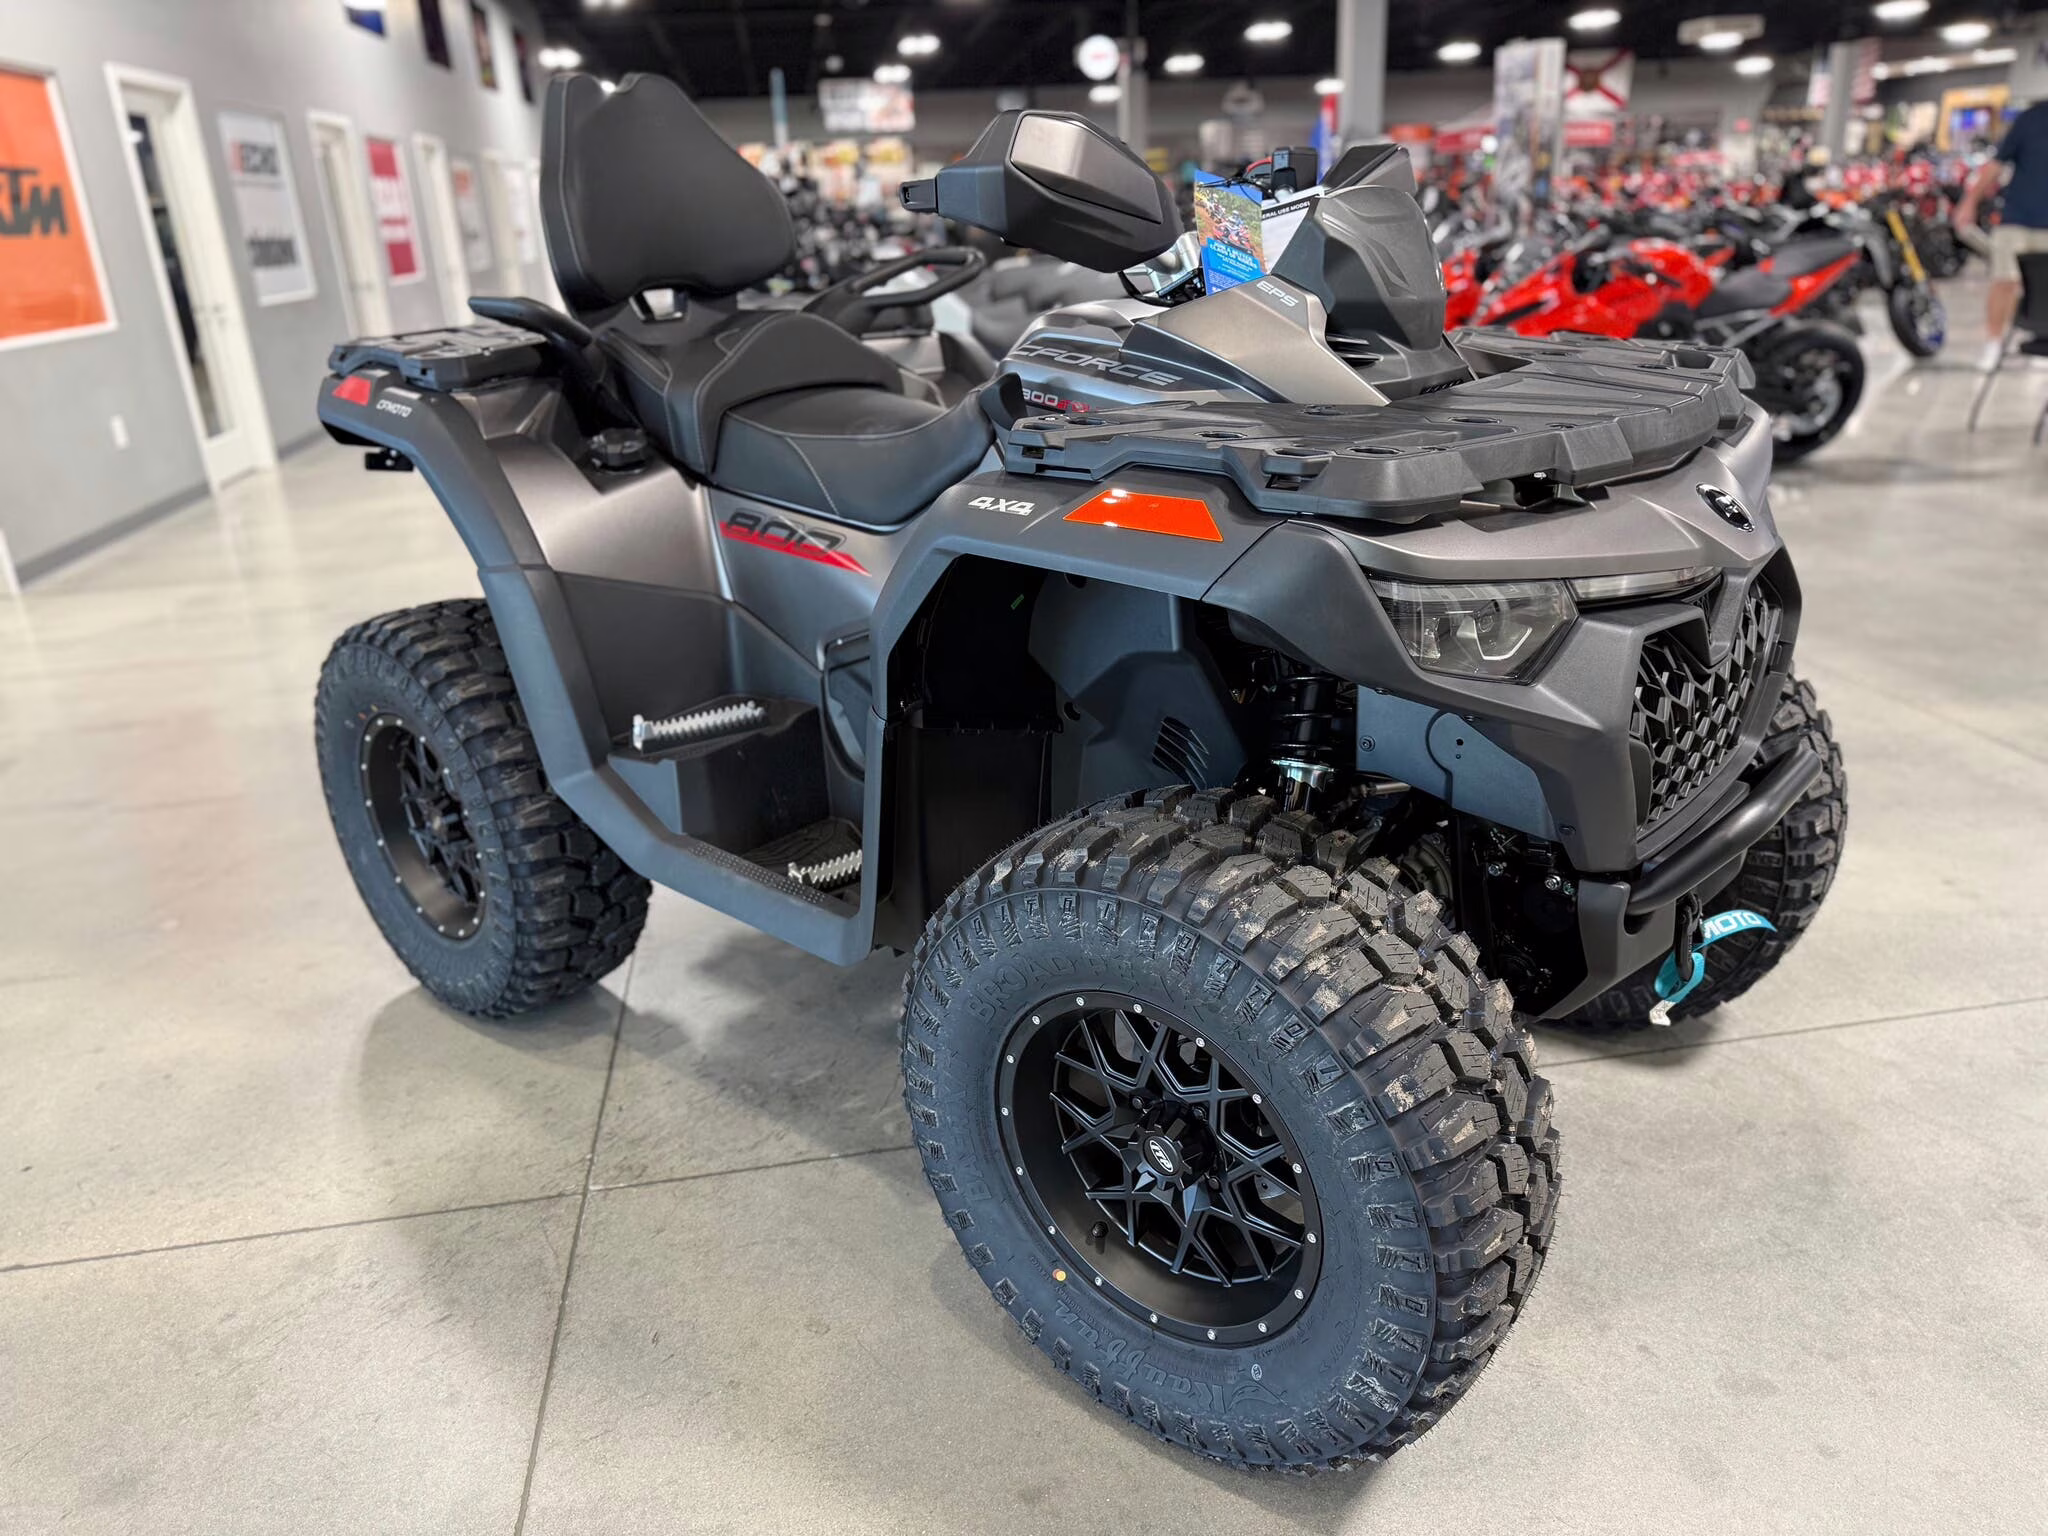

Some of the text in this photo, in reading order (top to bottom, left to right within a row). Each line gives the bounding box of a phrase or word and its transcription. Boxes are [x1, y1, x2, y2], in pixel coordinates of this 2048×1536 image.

[0, 168, 69, 235] TM
[1256, 281, 1299, 307] EPS
[1007, 342, 1184, 386] CFORCE
